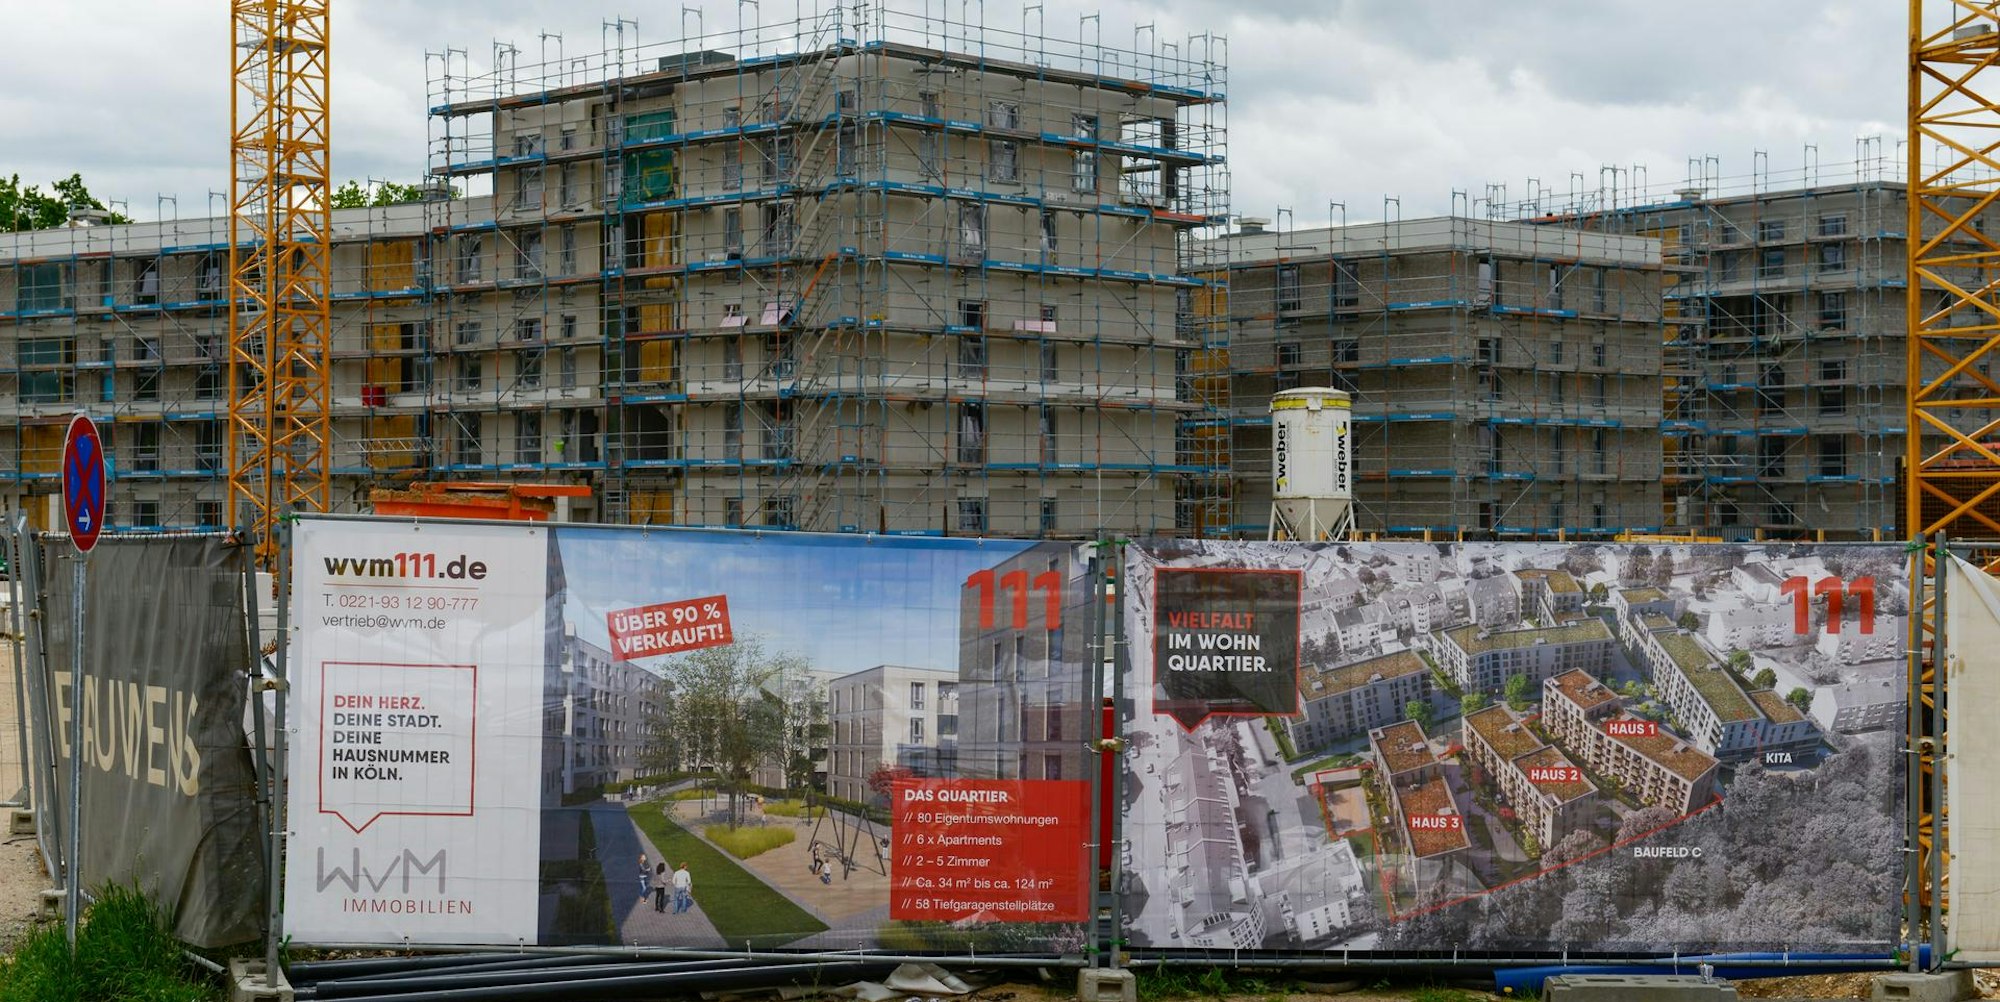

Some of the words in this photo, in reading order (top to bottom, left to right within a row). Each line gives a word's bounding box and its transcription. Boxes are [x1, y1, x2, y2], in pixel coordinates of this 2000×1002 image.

[1276, 421, 1286, 478] weber
[1337, 435, 1348, 492] weber
[324, 552, 487, 580] wvm111.de
[323, 593, 334, 607] T.
[339, 594, 400, 609] 0221-93
[406, 596, 422, 610] 12
[427, 596, 479, 611] 90-777
[967, 569, 1062, 631] 111
[1780, 575, 1875, 635] 111
[322, 614, 446, 630] vertrieb@wvm.de
[614, 611, 669, 633] ÜBER
[672, 606, 698, 624] 90
[703, 602, 721, 620] %
[1168, 611, 1255, 629] VIELFALT
[617, 623, 724, 654] VERKAUFT!
[1168, 633, 1192, 650] IM
[1197, 633, 1260, 651] WOHN
[1168, 654, 1273, 672] QUARTIER.
[334, 695, 373, 709] DEIN
[379, 696, 425, 710] HERZ.
[333, 713, 382, 726] DEINE
[387, 714, 442, 728] STADT.
[1609, 723, 1645, 734] HAUS
[1648, 723, 1655, 734] 1
[333, 731, 382, 744] DEINE
[333, 748, 450, 764] HAUSNUMMER
[1765, 752, 1793, 764] KITA
[332, 766, 348, 779] IN
[354, 764, 403, 780] KÖLN.
[1531, 769, 1567, 780] HAUS
[1570, 769, 1578, 780] 2
[904, 789, 934, 802] DAS
[937, 790, 1008, 803] QUARTIER
[917, 812, 932, 824] 80
[935, 813, 1059, 826] Eigentumswohnungen
[1412, 817, 1447, 828] HAUS
[1450, 817, 1460, 828] 3
[916, 834, 925, 845] 6
[927, 837, 934, 845] x
[937, 834, 1002, 847] Apartments
[1633, 847, 1689, 858] BAUFELD
[1691, 847, 1702, 858] C
[916, 855, 924, 866] 2
[936, 856, 944, 867] 5
[946, 856, 990, 867] Zimmer
[916, 876, 935, 888] Ca.
[938, 877, 952, 888] 34
[974, 878, 991, 889] bis
[993, 881, 1011, 889] ca.
[1015, 878, 1035, 889] 124
[343, 898, 472, 914] IMMOBILIEN
[915, 899, 930, 910] 58
[932, 899, 1055, 912] Tiefgaragenstellplätze
